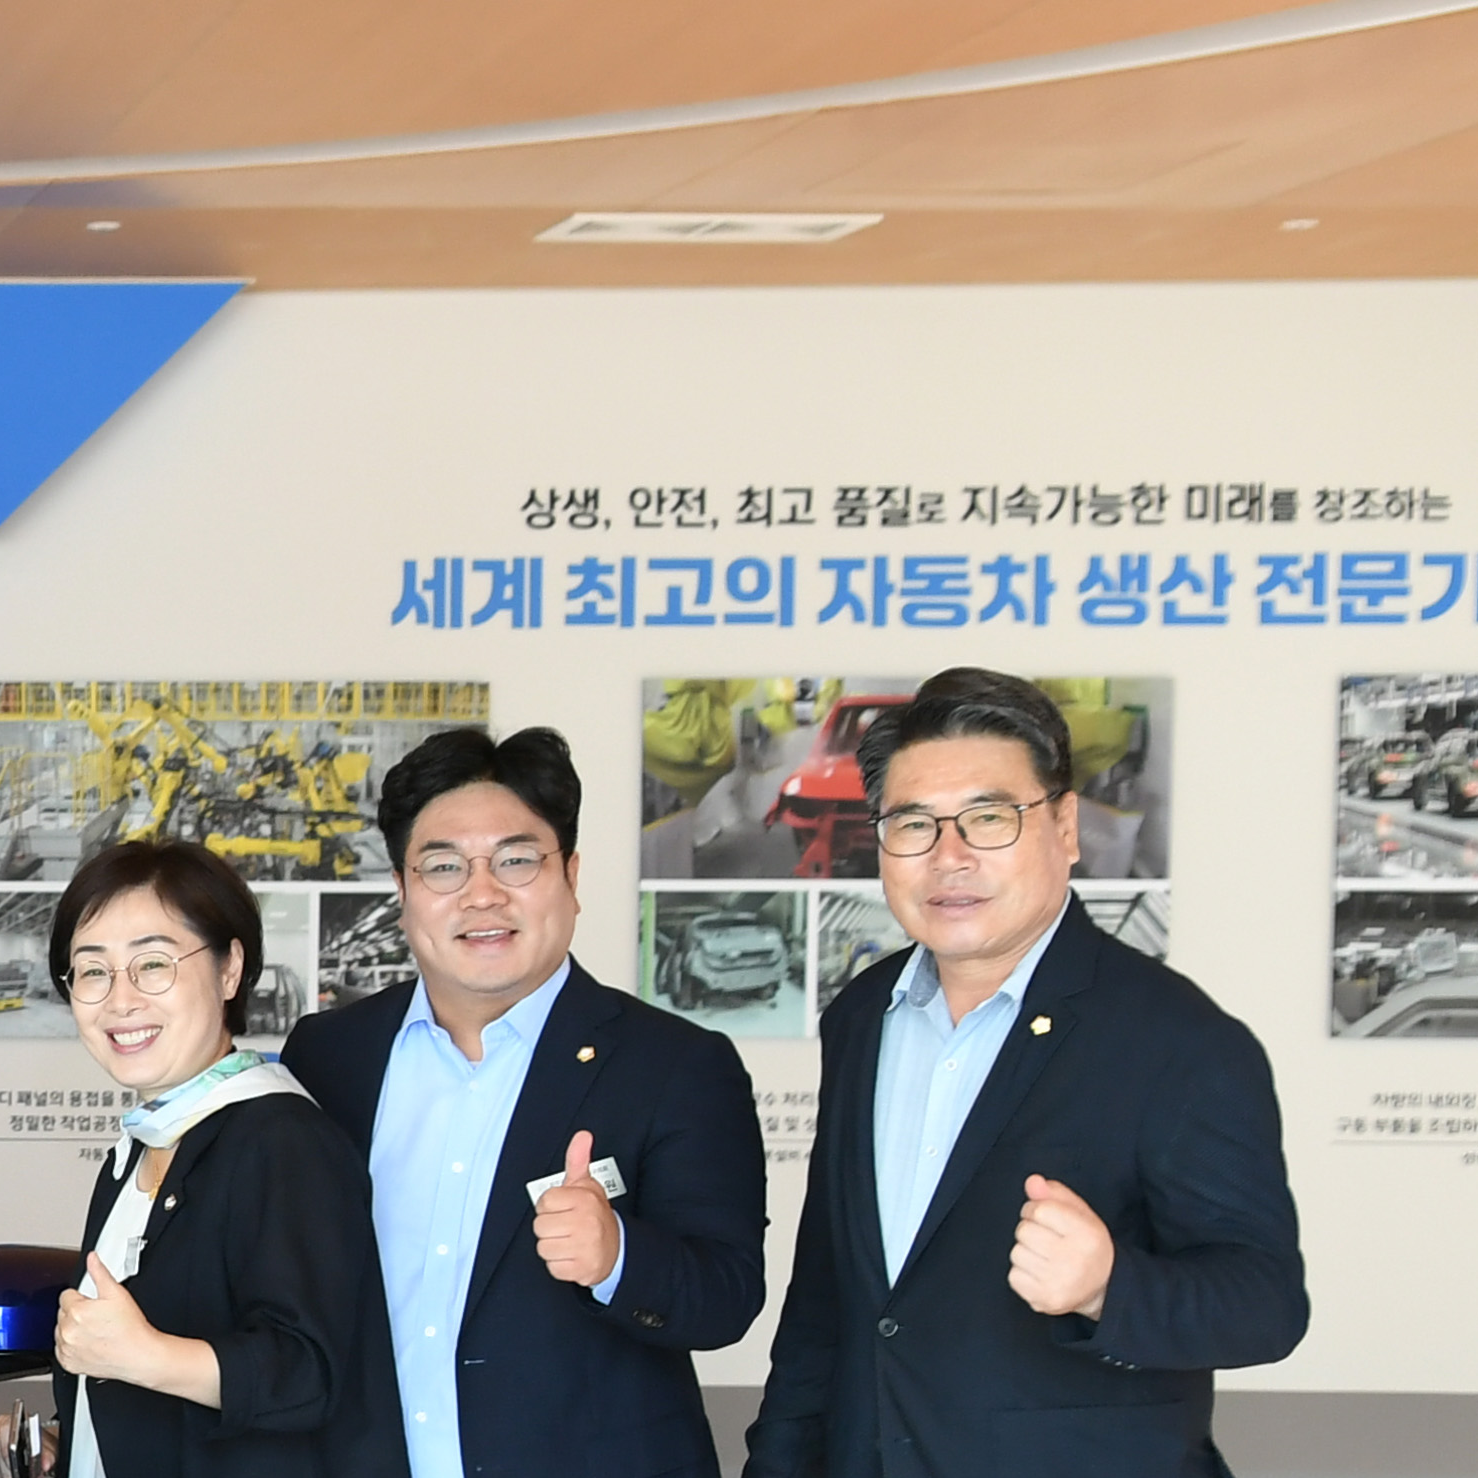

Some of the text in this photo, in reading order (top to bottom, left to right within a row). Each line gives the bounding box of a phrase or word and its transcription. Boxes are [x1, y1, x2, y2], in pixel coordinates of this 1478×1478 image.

[521, 482, 1453, 531] 상생, 안전, 최고 품질로 지속가능한 미래를 창조하는
[390, 555, 544, 630] 세계
[564, 554, 796, 629] 최고의
[817, 552, 1056, 628] 자동차
[1077, 551, 1236, 628] 생산
[16, 1089, 65, 1108] 패널의
[69, 1089, 116, 1108] 용접을
[8, 1114, 57, 1132] 정밀한
